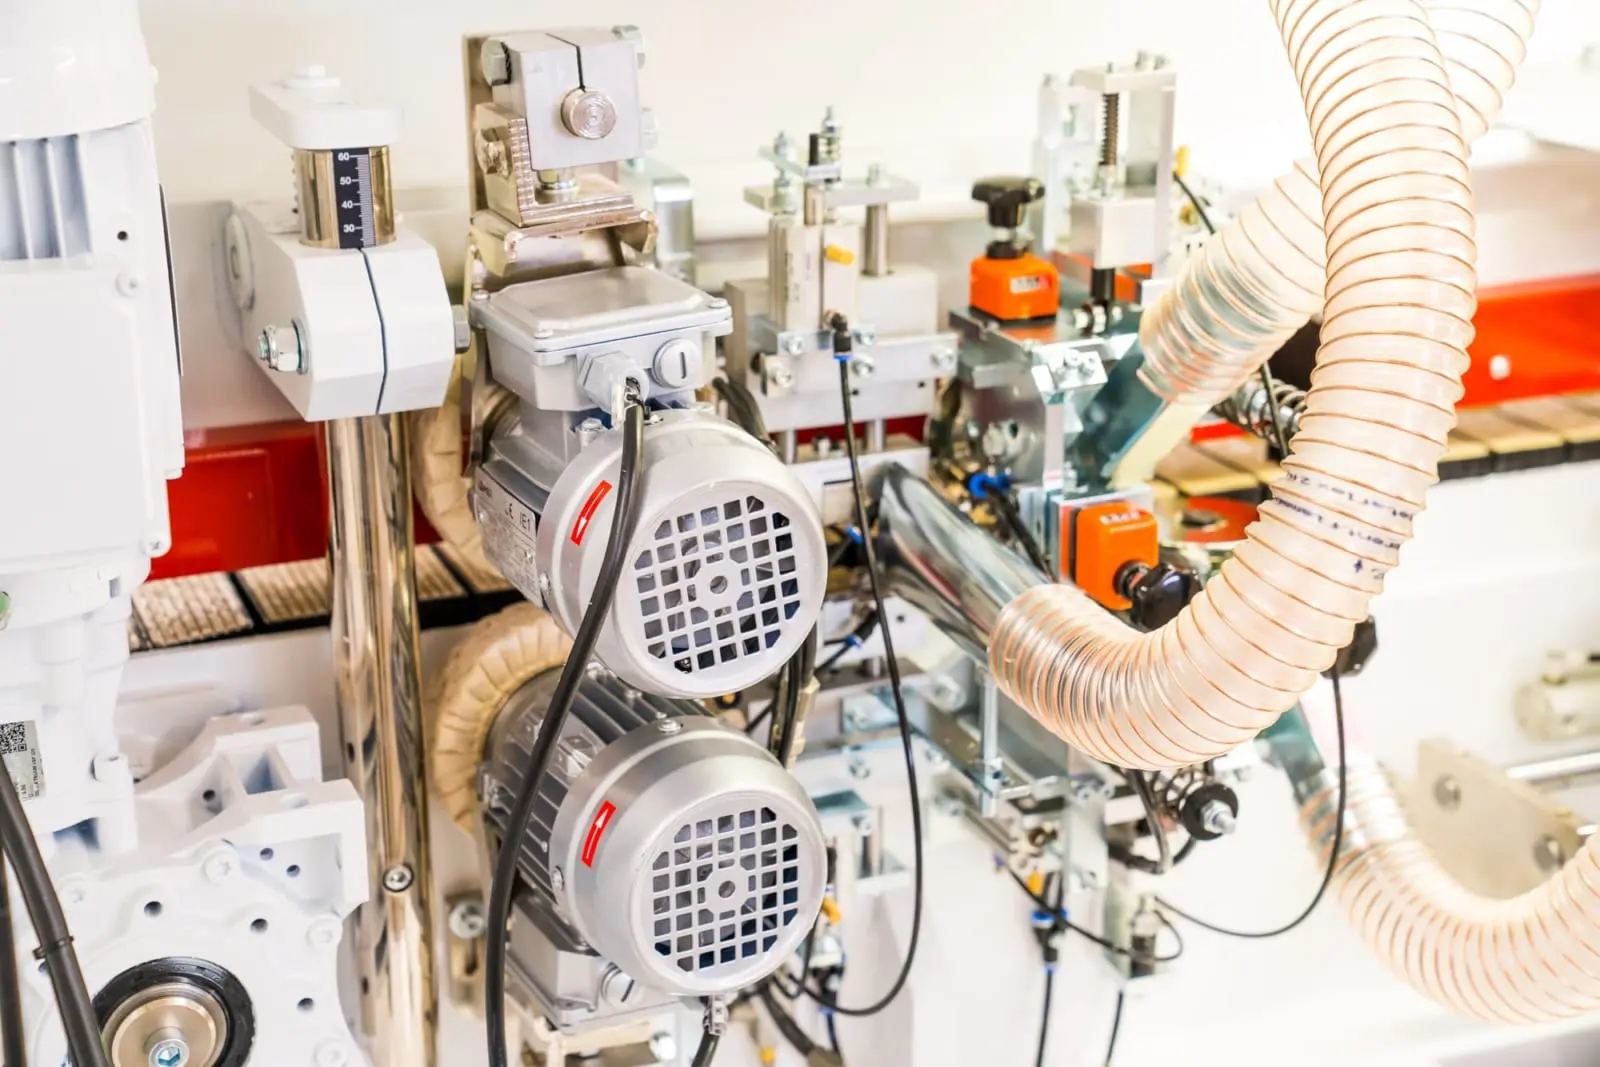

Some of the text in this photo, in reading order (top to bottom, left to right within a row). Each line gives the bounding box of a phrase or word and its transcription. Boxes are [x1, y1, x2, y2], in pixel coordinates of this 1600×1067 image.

[338, 152, 350, 161] 60
[340, 176, 352, 185] 50
[341, 200, 353, 209] 40
[343, 224, 355, 233] 30
